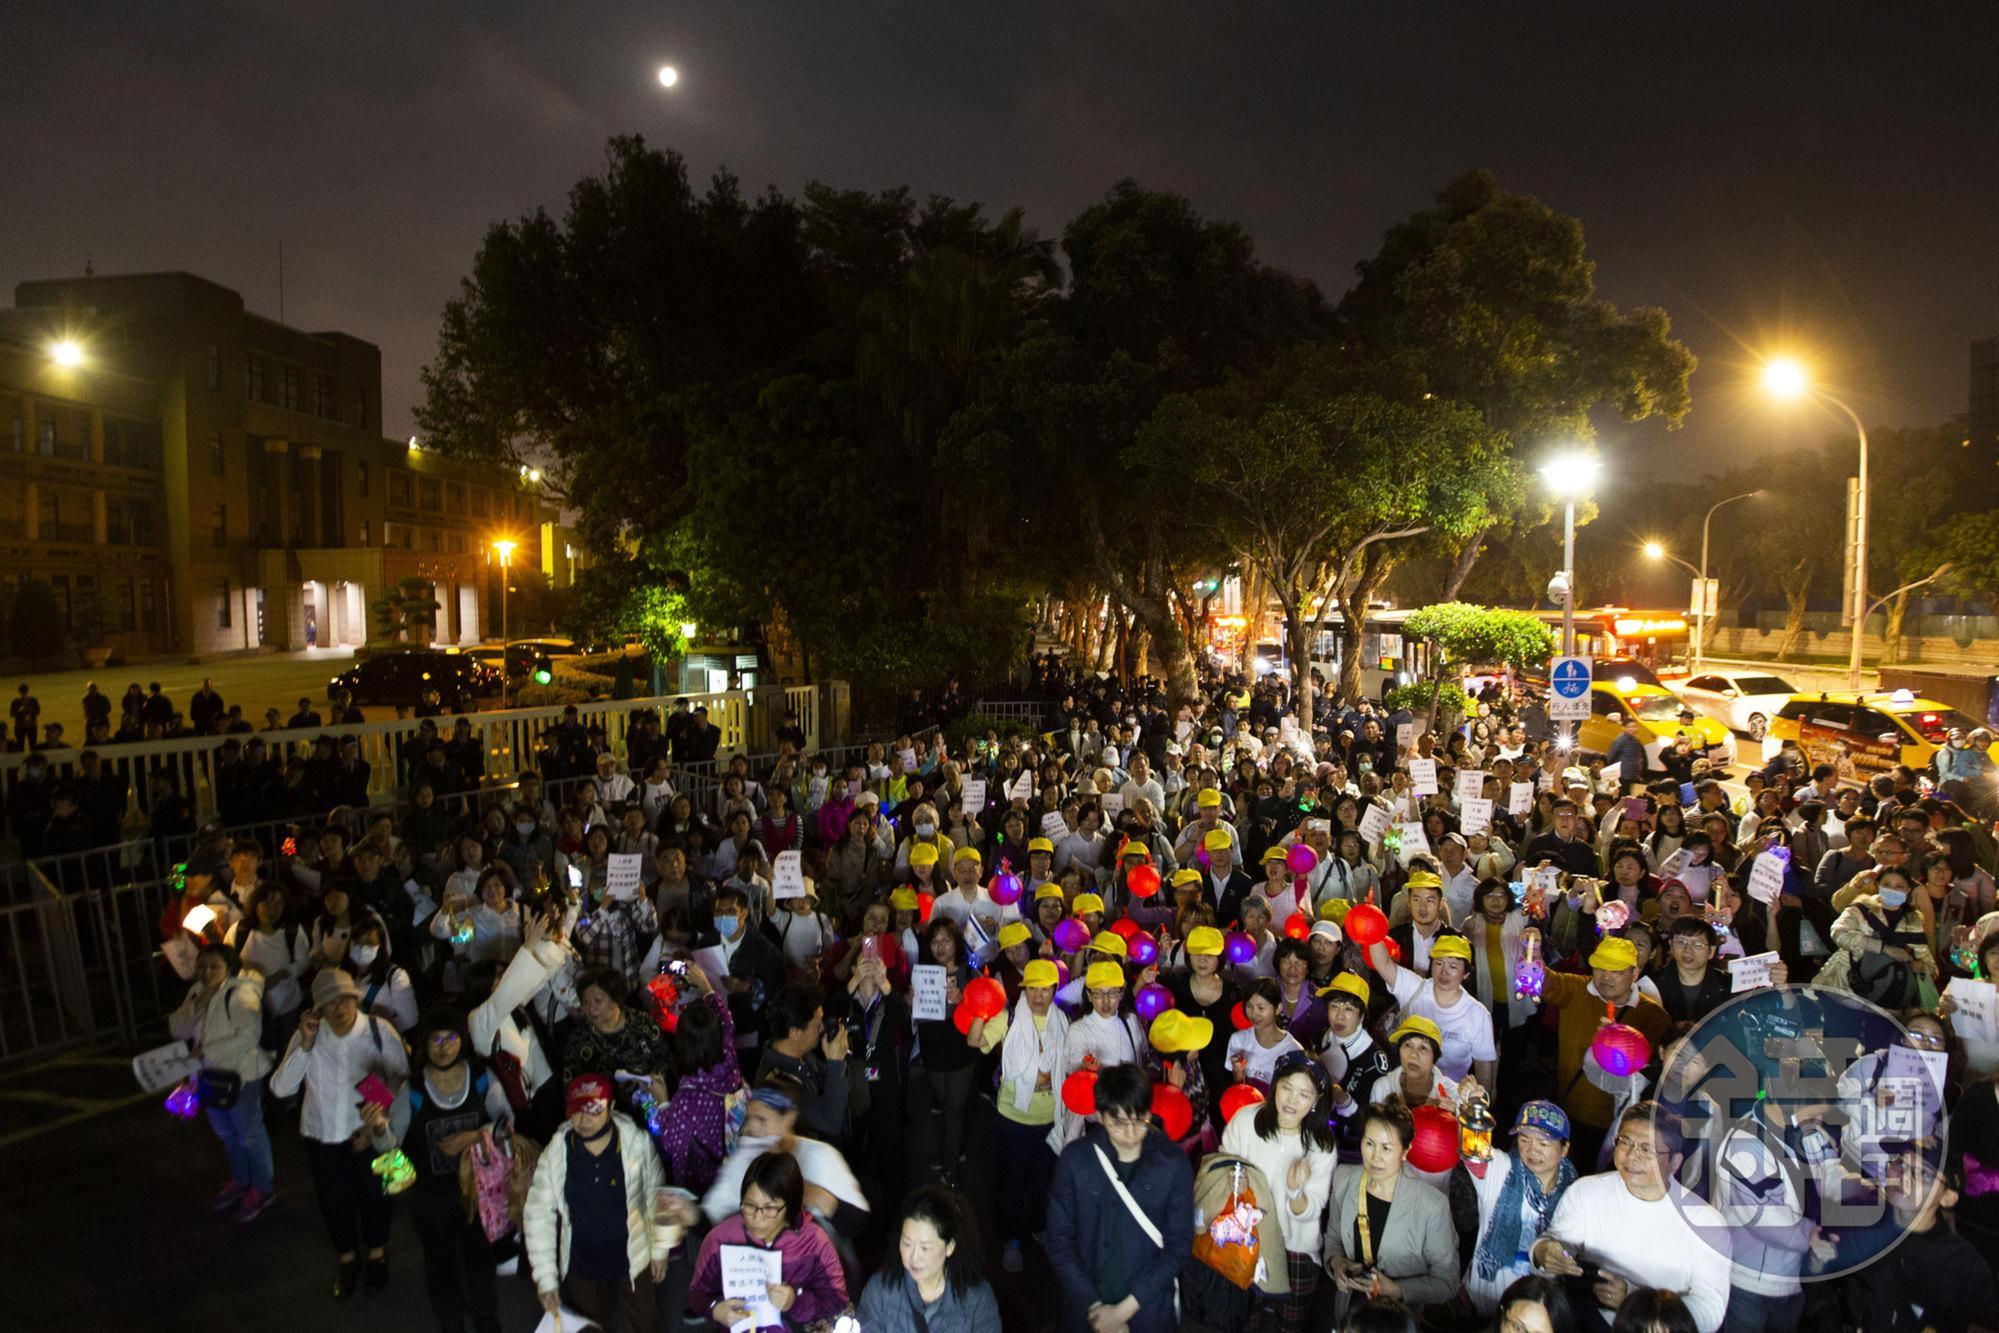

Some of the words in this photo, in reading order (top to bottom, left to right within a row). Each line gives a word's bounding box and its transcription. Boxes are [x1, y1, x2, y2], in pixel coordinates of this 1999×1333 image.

[1552, 702, 1590, 711] 行人優先
[1379, 1053, 1389, 1071] B
